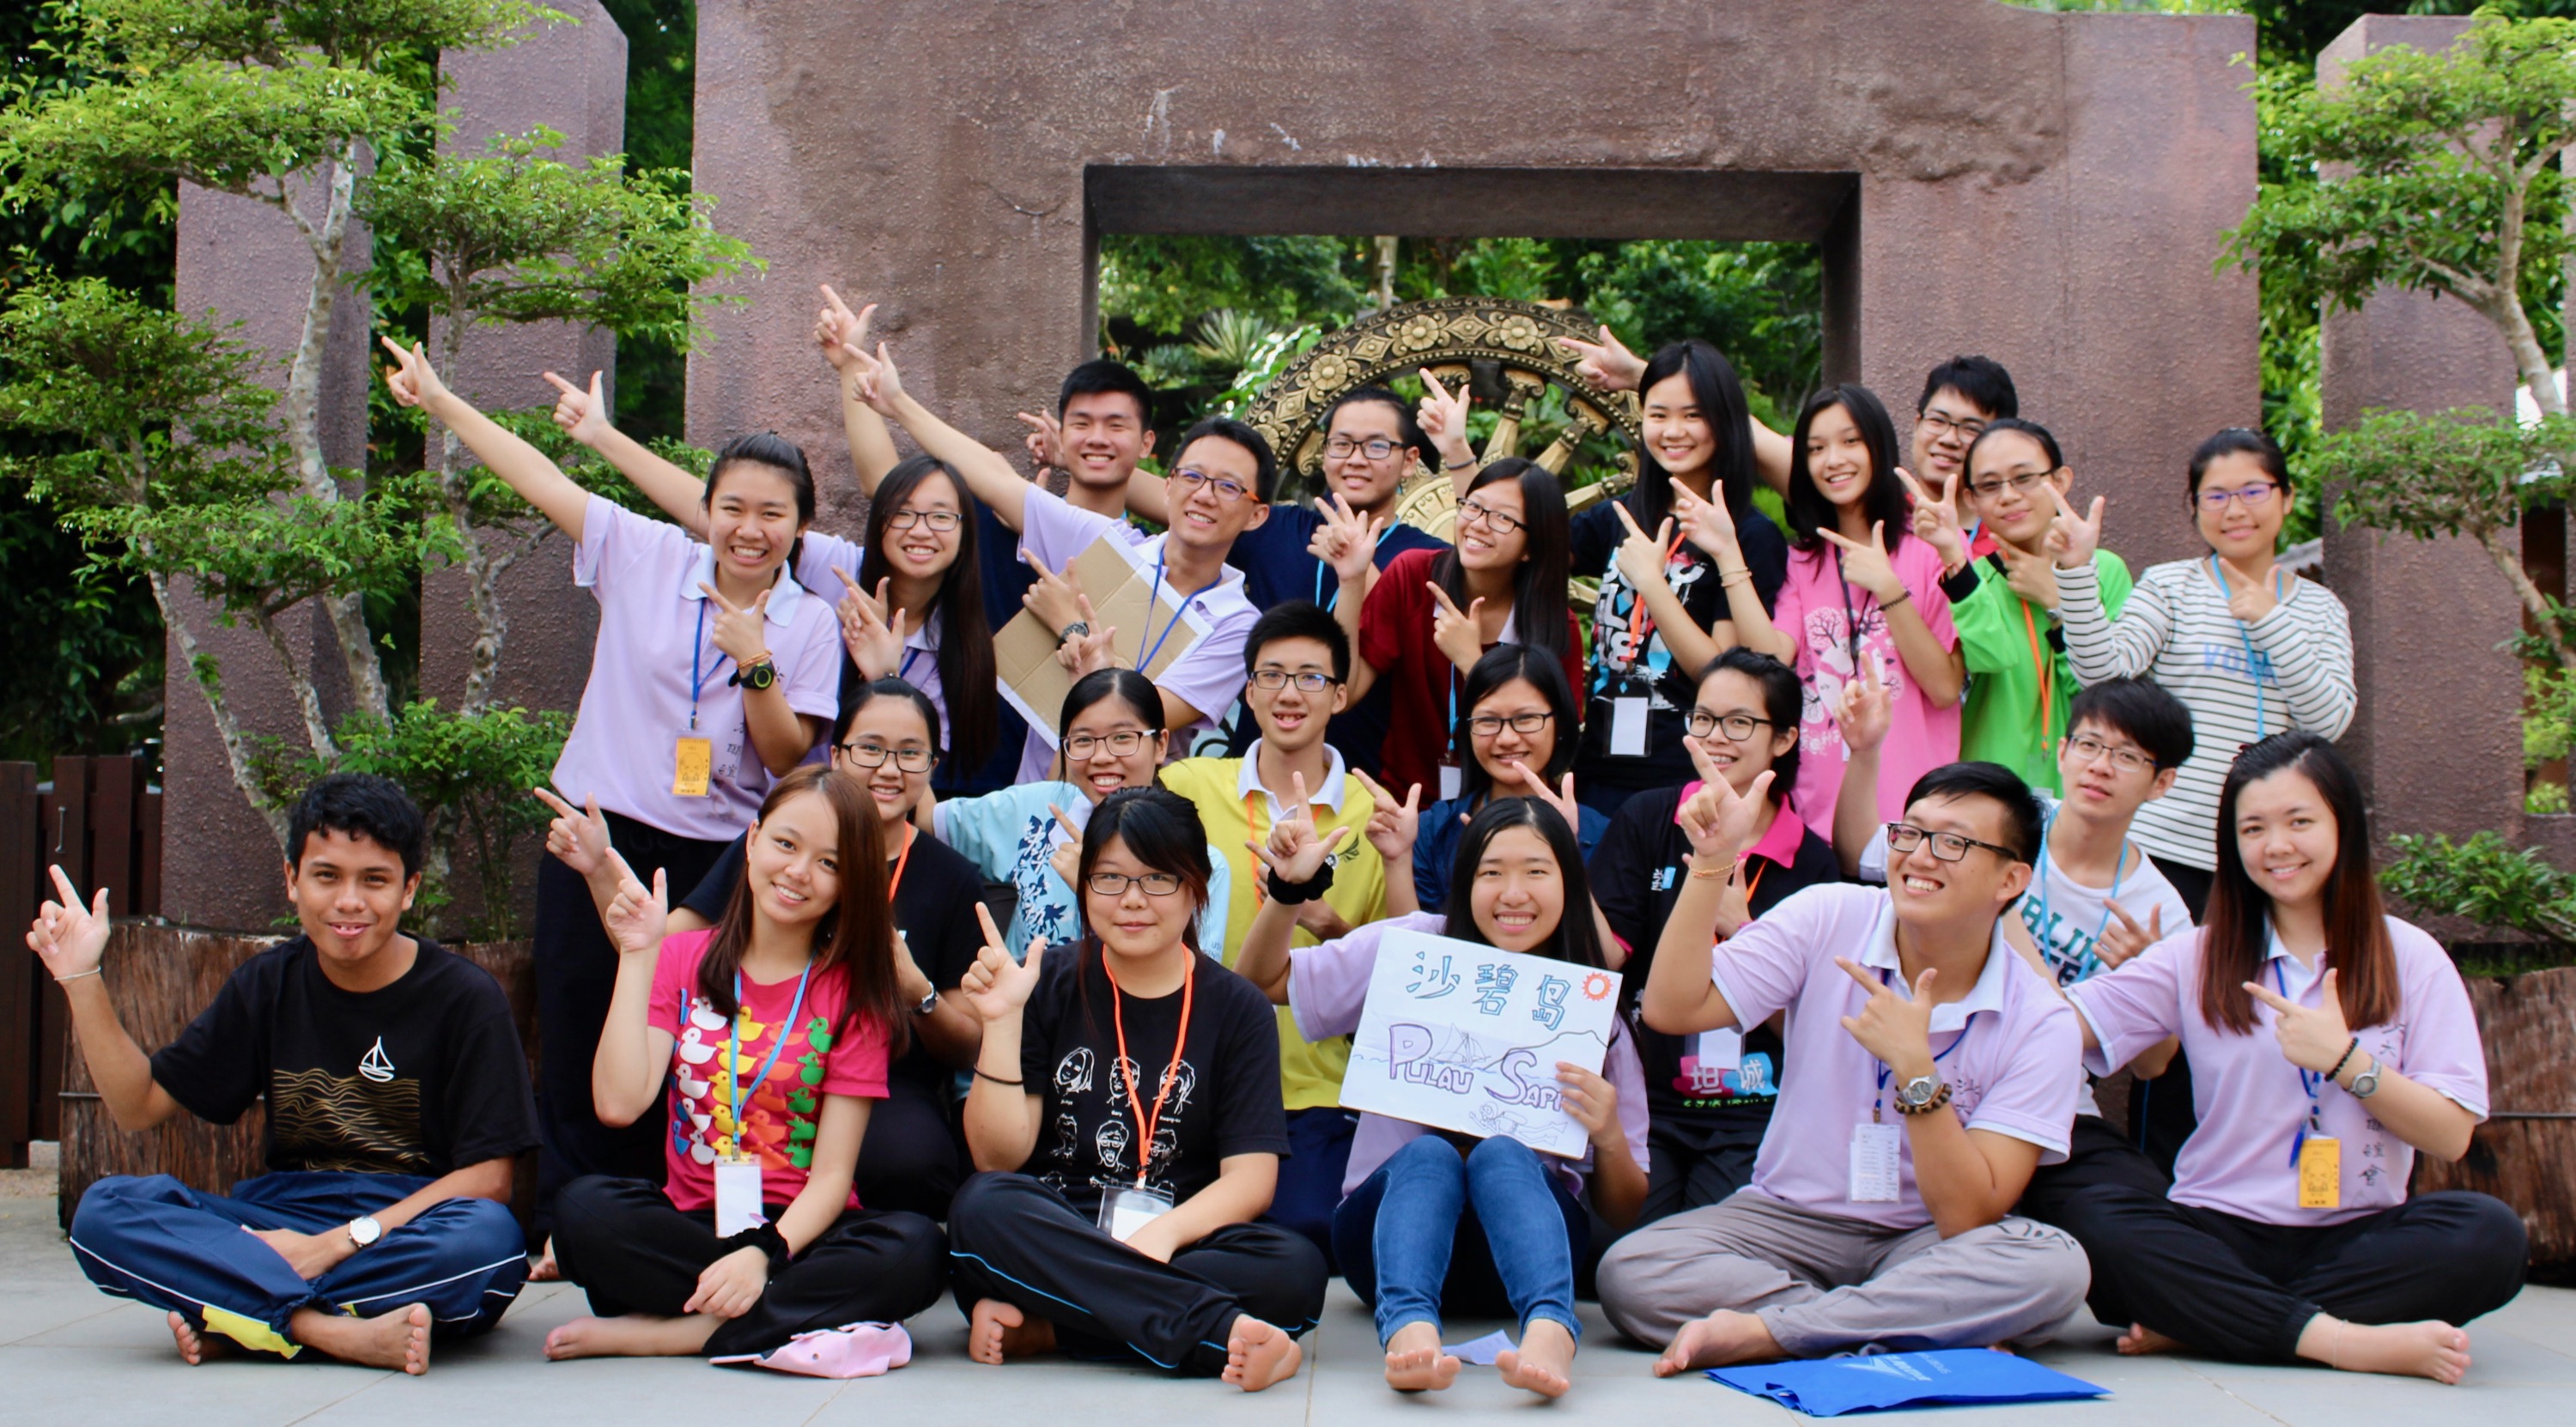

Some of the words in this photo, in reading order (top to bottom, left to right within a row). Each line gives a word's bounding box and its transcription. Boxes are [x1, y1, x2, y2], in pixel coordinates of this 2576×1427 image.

[1406, 950, 1571, 1030] 沙碧岛
[1388, 1023, 1474, 1095] PULAU
